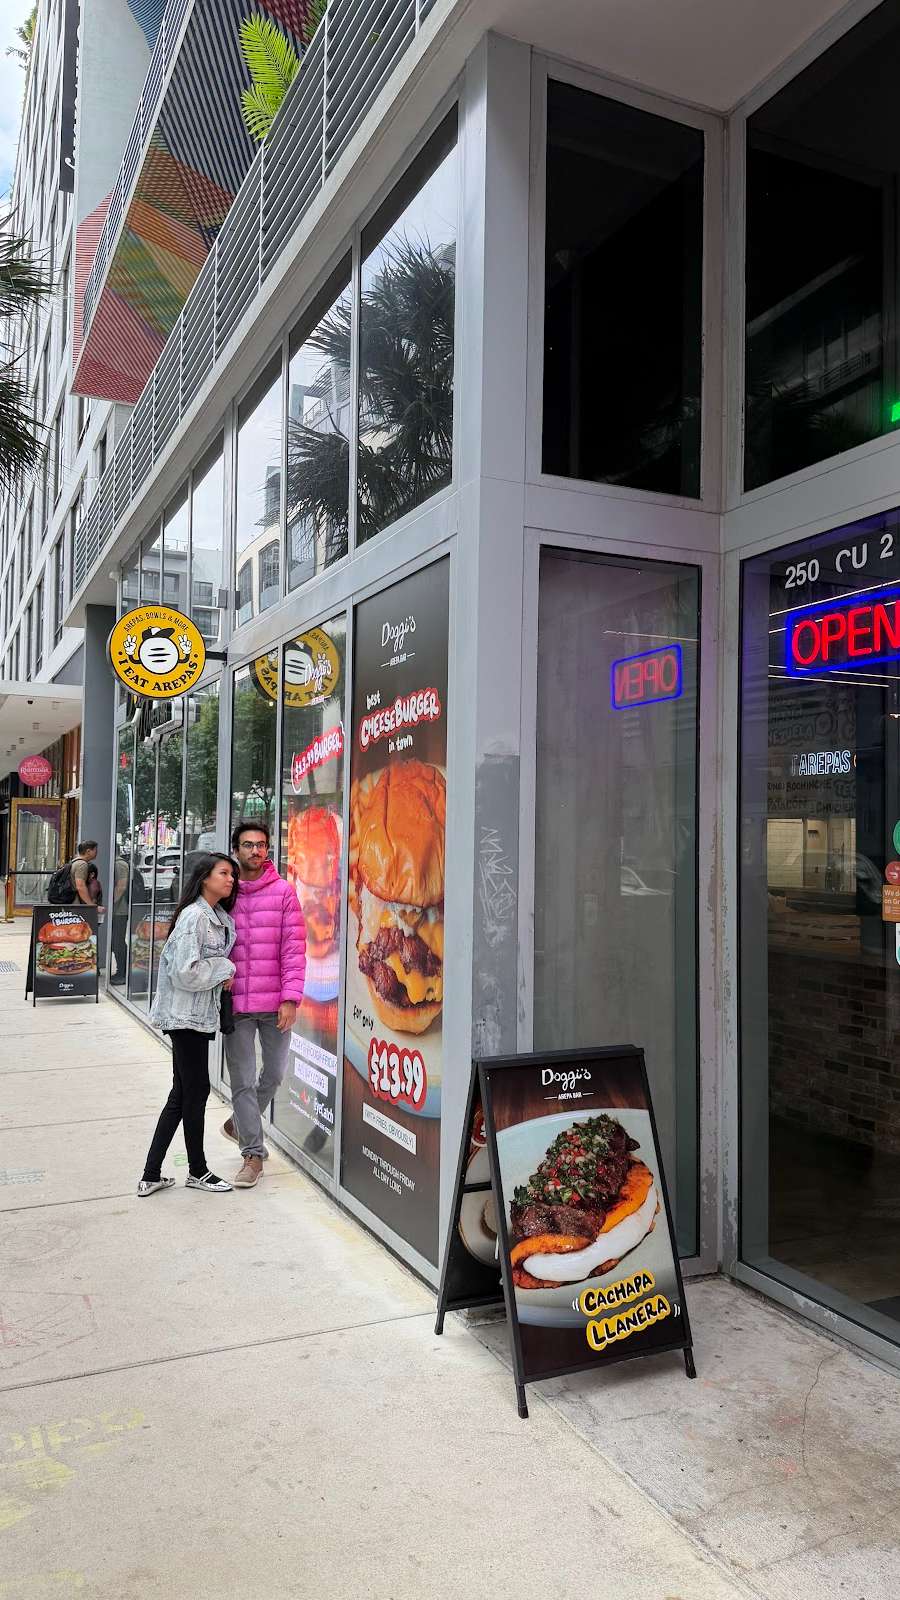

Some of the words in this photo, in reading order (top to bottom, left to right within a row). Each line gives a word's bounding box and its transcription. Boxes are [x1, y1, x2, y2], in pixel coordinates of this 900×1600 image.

[785, 559, 820, 589] 250
[880, 533, 894, 559] 2
[381, 615, 416, 653] Doggi's
[792, 600, 900, 665] OPEN
[123, 666, 149, 689] EAT
[152, 661, 198, 691] AREPAS
[366, 690, 381, 710] best
[361, 691, 439, 747] CHEESEBURGER
[388, 738, 395, 753] in
[395, 734, 413, 752] town
[799, 749, 851, 776] AREPAS
[353, 1004, 362, 1020] for
[362, 1015, 374, 1031] only
[371, 1043, 424, 1104] $13.99
[541, 1068, 592, 1091] Doggi's
[373, 1166, 381, 1179] ALL
[380, 1171, 390, 1185] DAY
[389, 1178, 402, 1196] LONG
[399, 1172, 415, 1191] FRIDAY
[584, 1273, 652, 1311] CACHAPA
[592, 1298, 667, 1345] LLANERA
